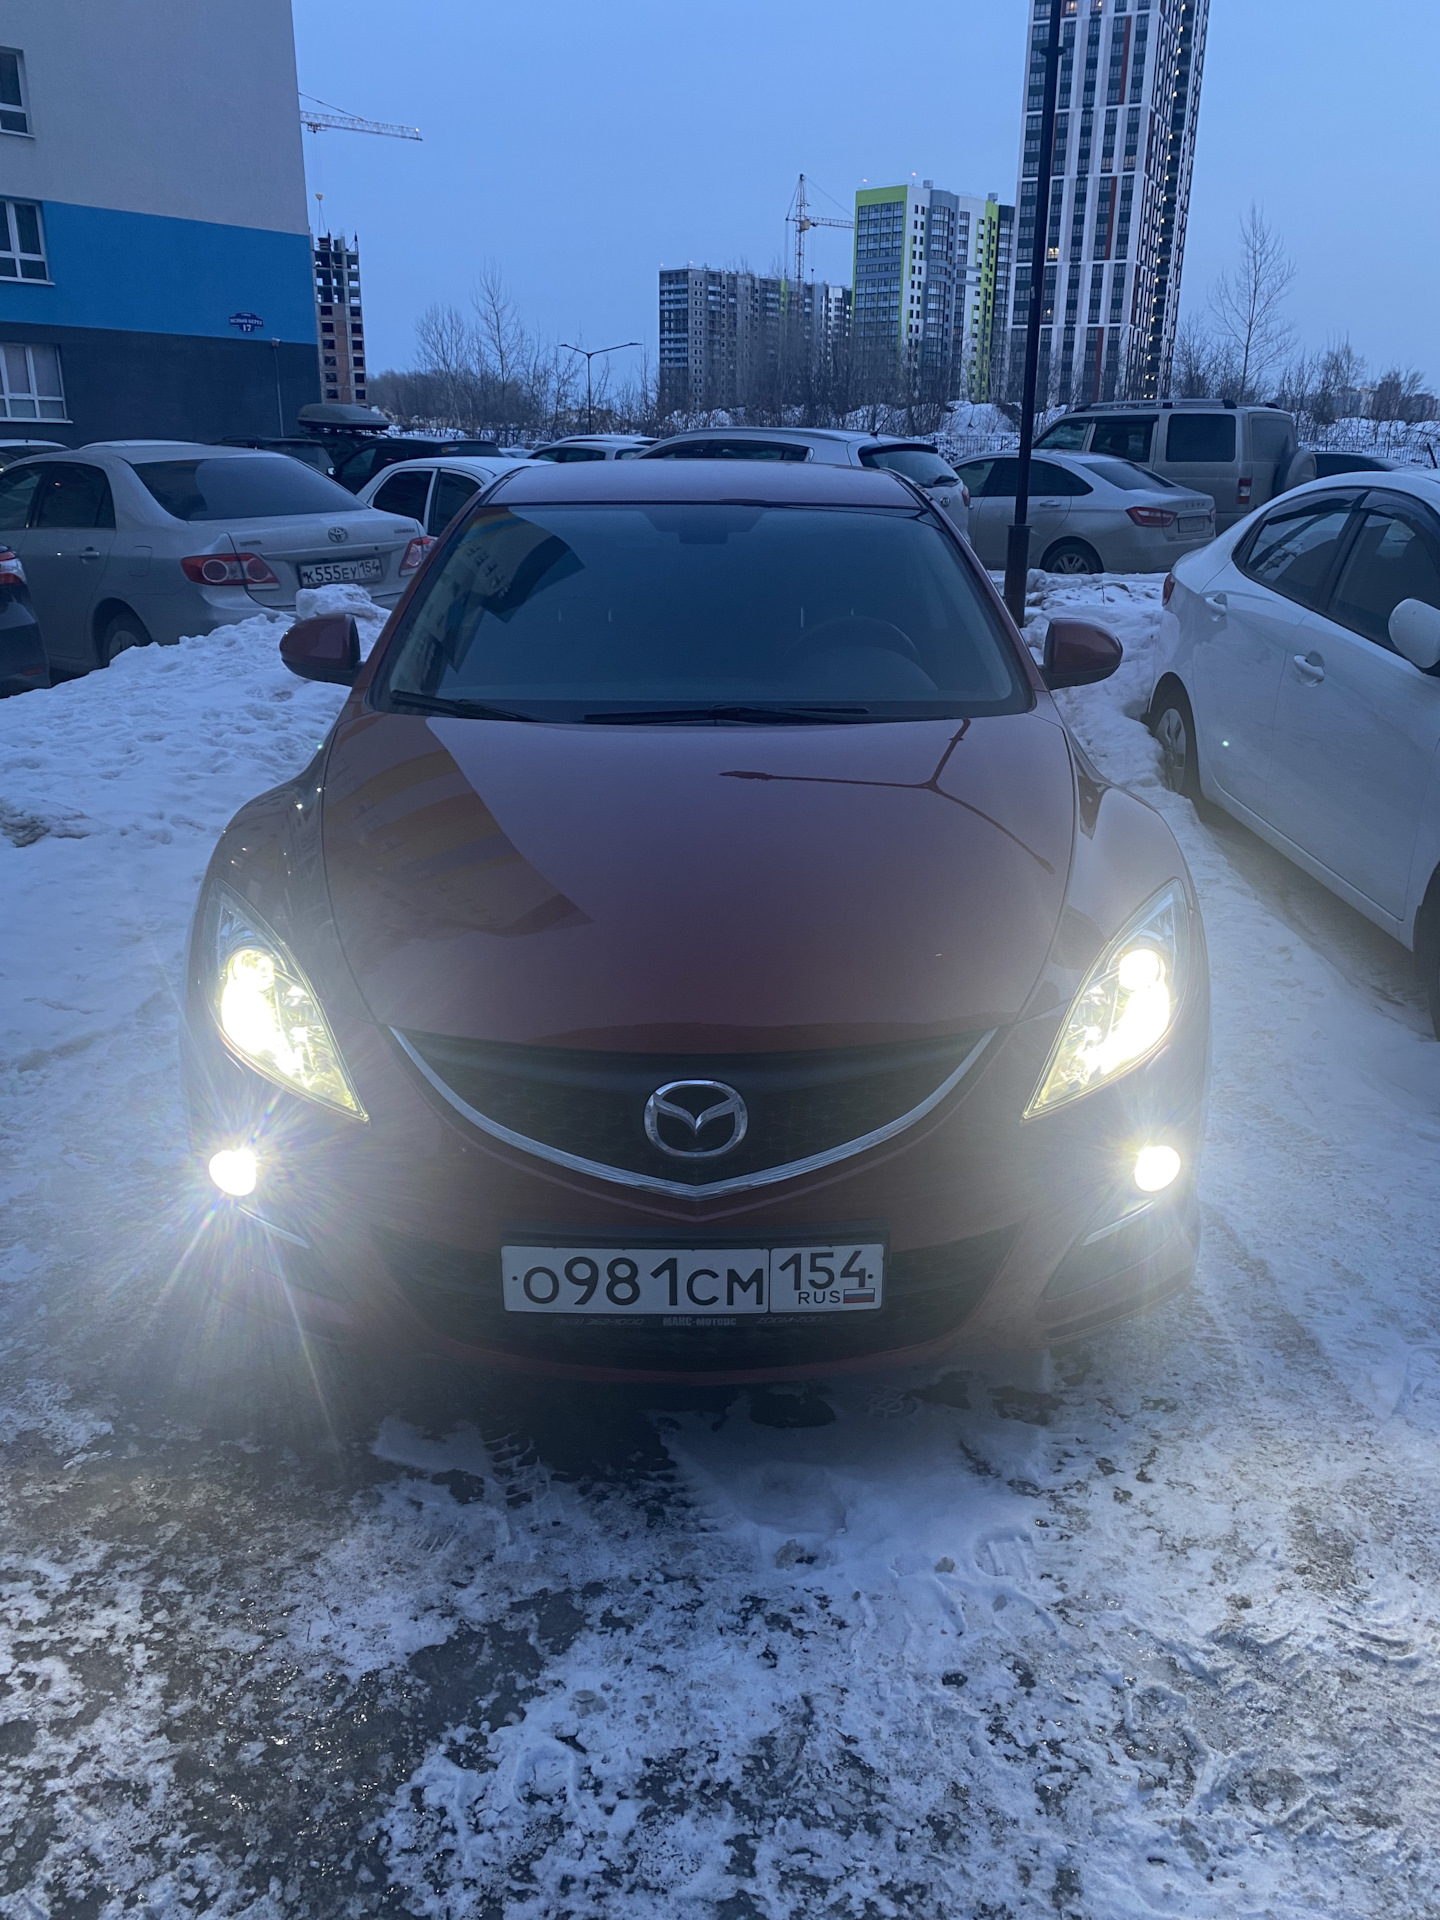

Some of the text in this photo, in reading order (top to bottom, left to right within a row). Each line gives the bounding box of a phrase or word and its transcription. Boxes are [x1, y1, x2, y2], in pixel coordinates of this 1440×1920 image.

[242, 324, 252, 332] 17
[360, 561, 379, 575] 154
[523, 1250, 867, 1306] О981СМ 154
[797, 1290, 842, 1305] RUS
